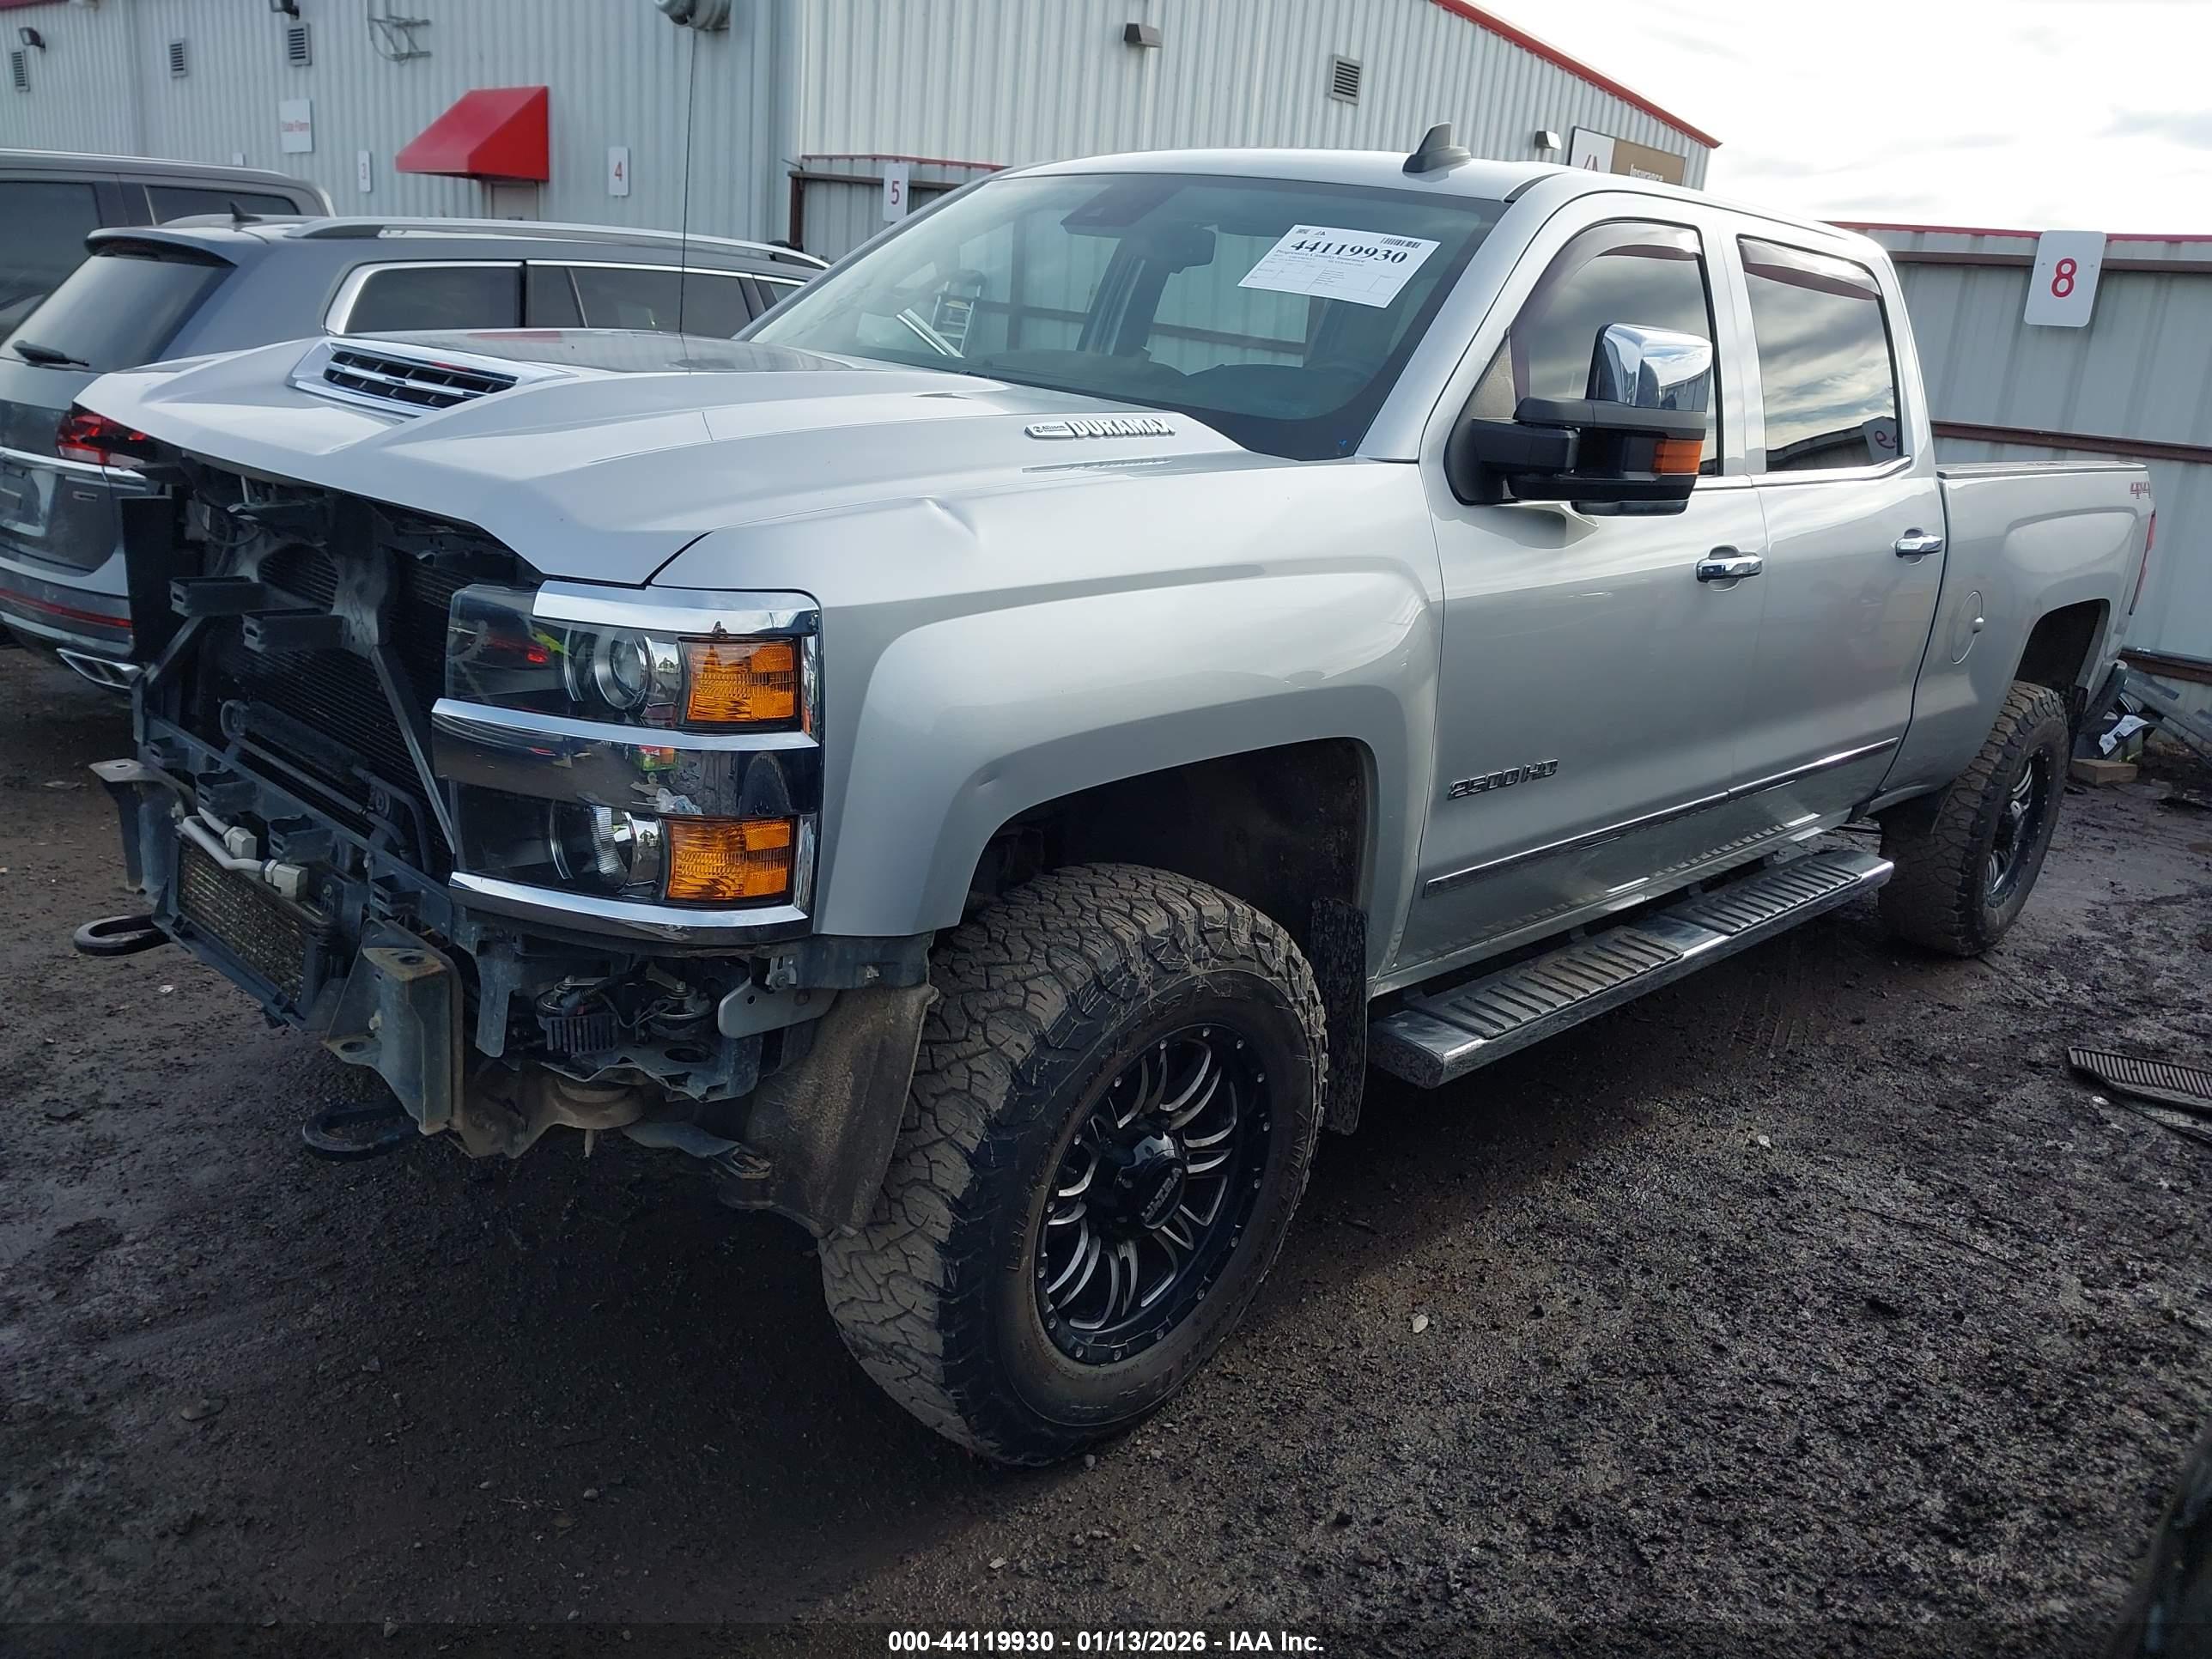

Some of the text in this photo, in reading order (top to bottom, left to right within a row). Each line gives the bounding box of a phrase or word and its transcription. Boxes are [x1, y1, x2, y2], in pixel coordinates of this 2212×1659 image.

[614, 161, 623, 182] 4
[890, 180, 900, 205] 5
[1291, 239, 1408, 264] 44119930
[2051, 258, 2078, 298] 8
[1071, 417, 1176, 438] DURAMAX
[1448, 758, 1559, 800] 2500 HD
